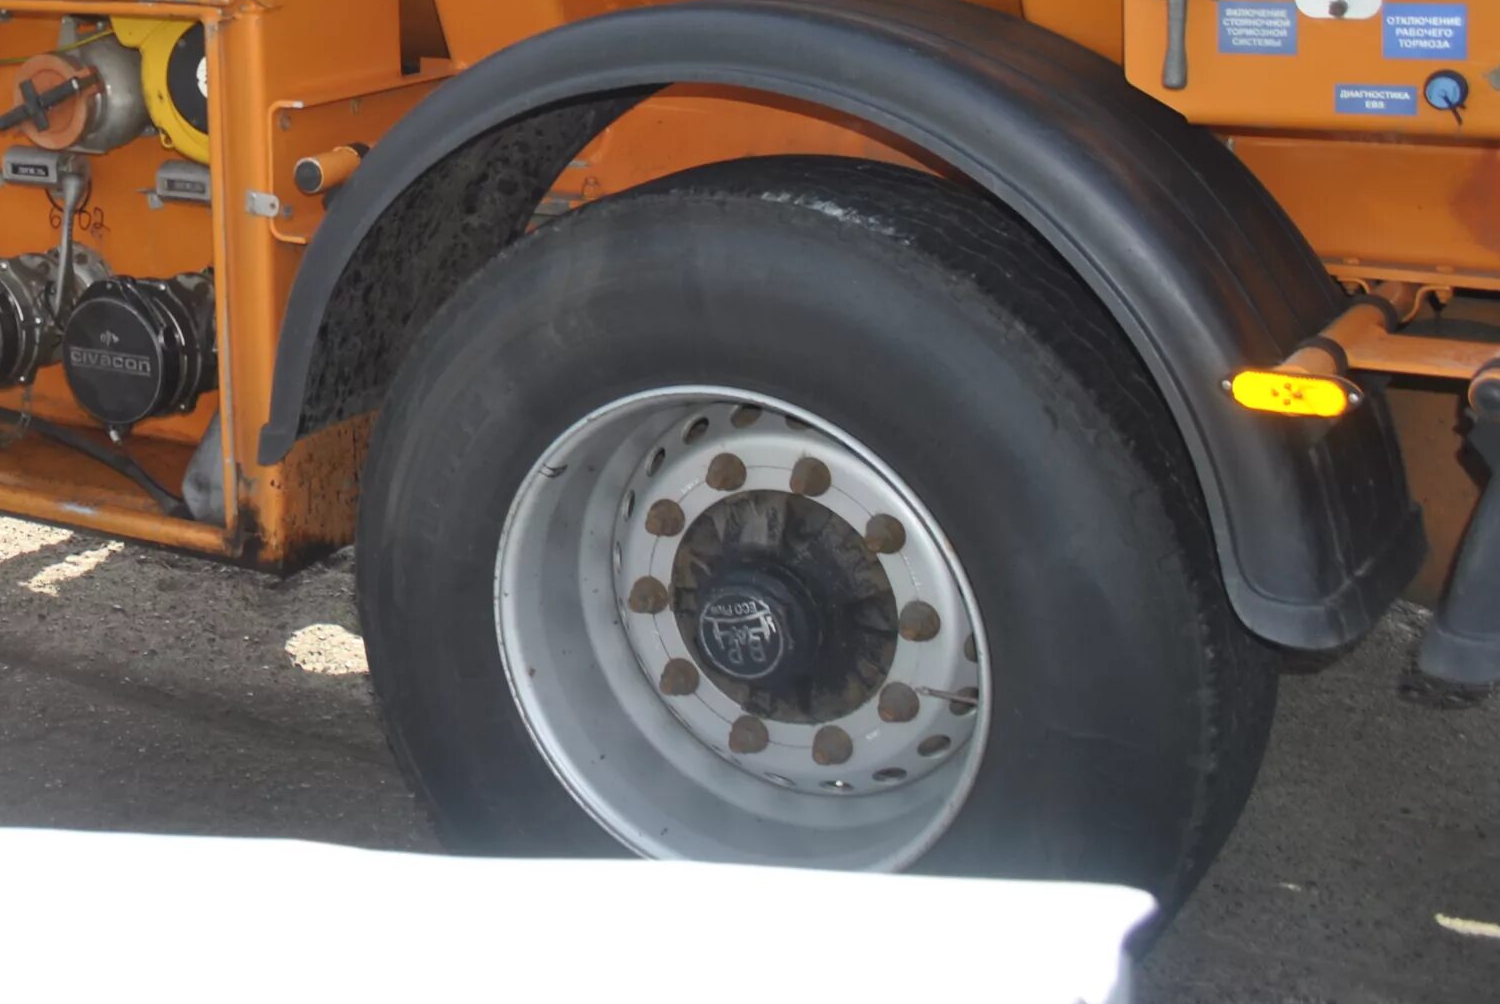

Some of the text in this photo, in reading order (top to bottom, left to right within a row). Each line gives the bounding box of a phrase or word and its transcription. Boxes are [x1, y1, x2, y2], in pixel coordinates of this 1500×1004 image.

[1386, 16, 1462, 27] ОТКЛЮЧЕНИЕ
[1395, 27, 1453, 38] РАБОЧЕГО
[1232, 37, 1282, 47] СИСТЕМЫ
[1399, 38, 1451, 49] ТОРМОЗА
[1339, 89, 1410, 101] ДИАГНОСТИКА
[1365, 100, 1385, 109] EBS
[70, 348, 151, 373] civacon
